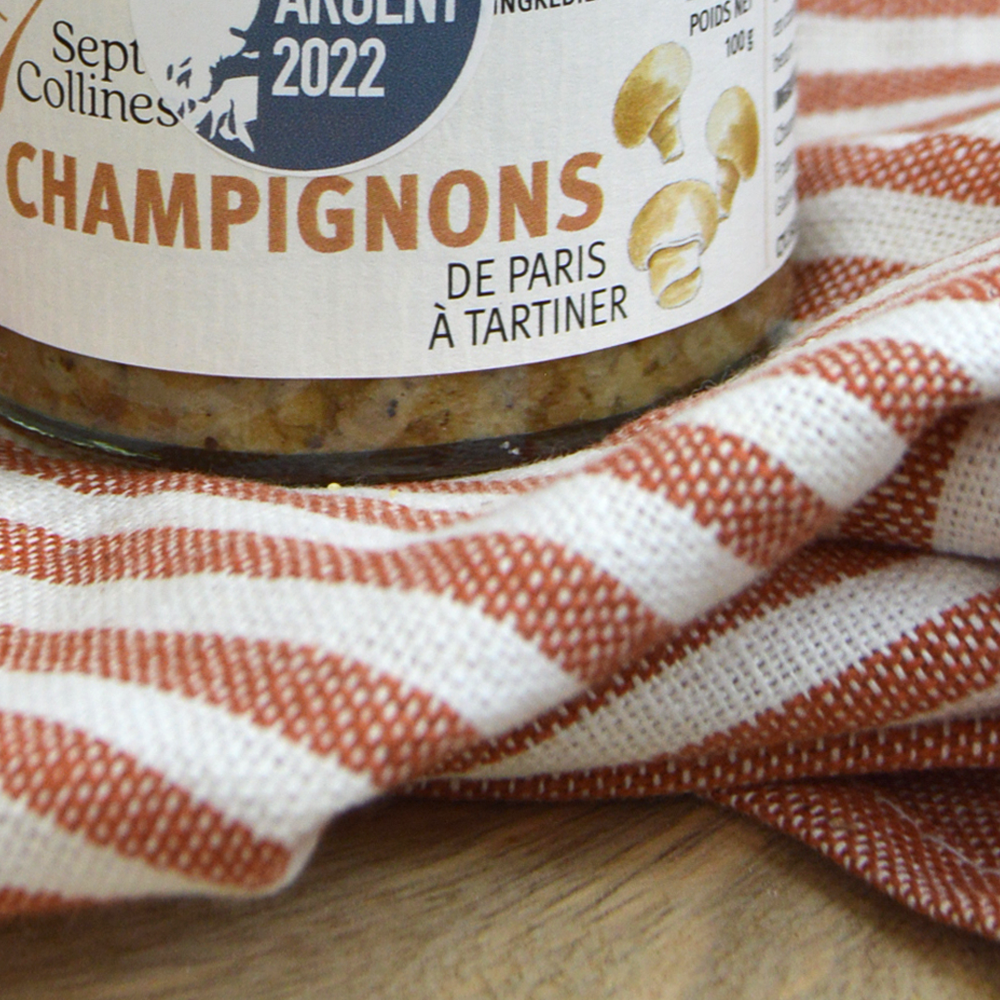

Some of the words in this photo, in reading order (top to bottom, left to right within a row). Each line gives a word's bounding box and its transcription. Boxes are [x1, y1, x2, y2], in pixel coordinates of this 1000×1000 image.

[52, 20, 146, 83] Sept
[271, 37, 386, 97] 2022
[724, 30, 746, 58] 100
[17, 60, 179, 127] Collines
[6, 141, 604, 253] CHAMPIGNONS
[448, 259, 496, 300] DE
[510, 241, 606, 293] PARIS
[428, 302, 455, 350] À
[464, 284, 628, 346] TARTINER
